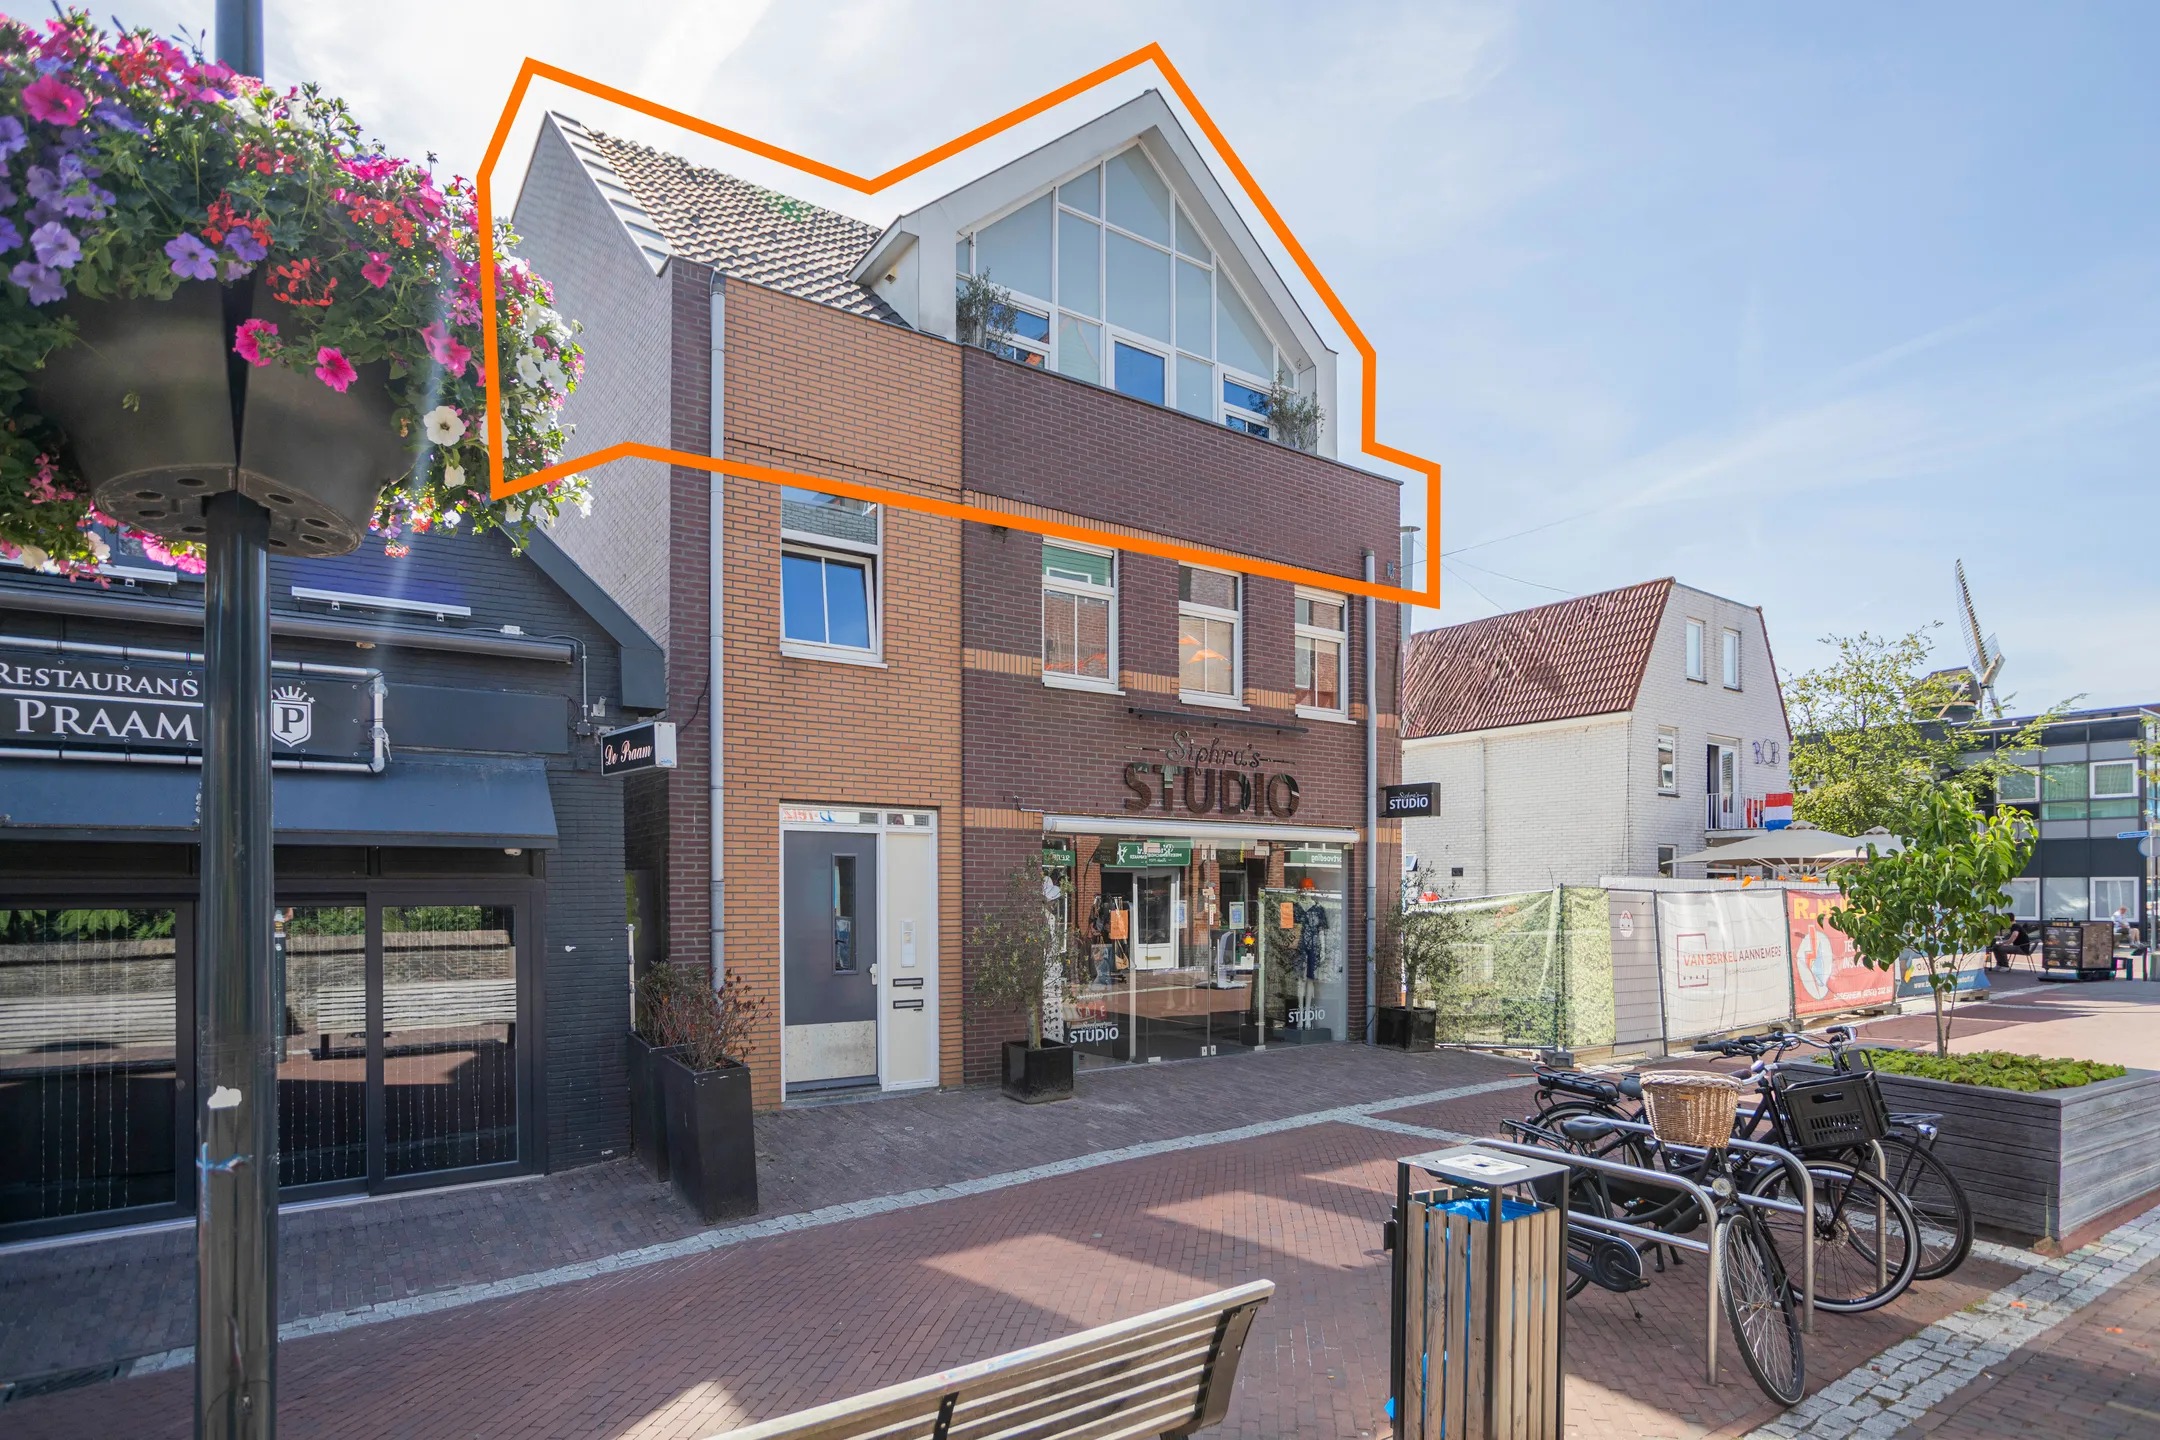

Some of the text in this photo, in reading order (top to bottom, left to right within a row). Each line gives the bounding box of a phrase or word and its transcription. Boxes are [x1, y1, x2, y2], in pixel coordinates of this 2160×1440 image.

[14, 698, 199, 742] PRAAM
[280, 706, 305, 734] P
[620, 740, 653, 763] Praam
[1166, 730, 1261, 776] Siphra's
[1124, 762, 1301, 818] STUDIO
[1389, 797, 1429, 810] STUDIO
[1683, 946, 1782, 967] VAN BERKEL AANNEMERS
[1288, 1008, 1326, 1023] STUDIO
[1069, 1026, 1119, 1044] STUDIO
